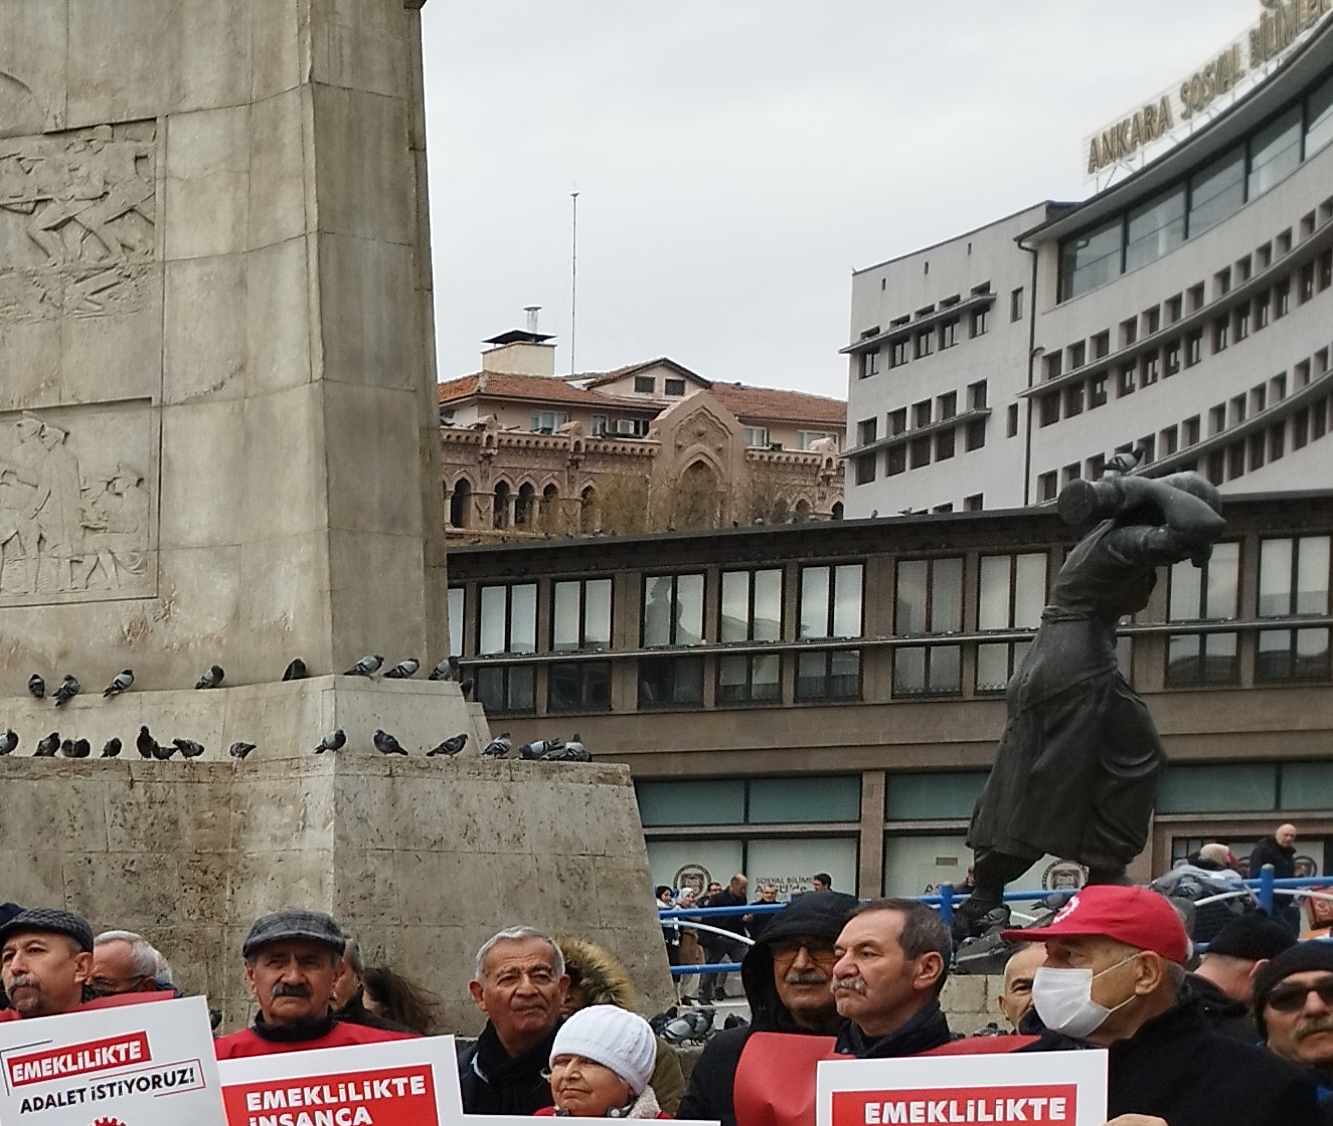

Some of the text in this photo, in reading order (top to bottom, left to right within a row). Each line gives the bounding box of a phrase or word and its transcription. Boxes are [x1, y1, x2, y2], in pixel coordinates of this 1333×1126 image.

[1087, 95, 1175, 175] ANKARA
[1179, 44, 1246, 120] SOSYAL
[12, 1040, 142, 1083] EMEKLİLİKTE
[20, 1067, 196, 1115] ADALET İSTİYORUZ!
[246, 1075, 426, 1112] EMEKLİLİKTE
[864, 1097, 1067, 1125] EMEKLİLİKTE
